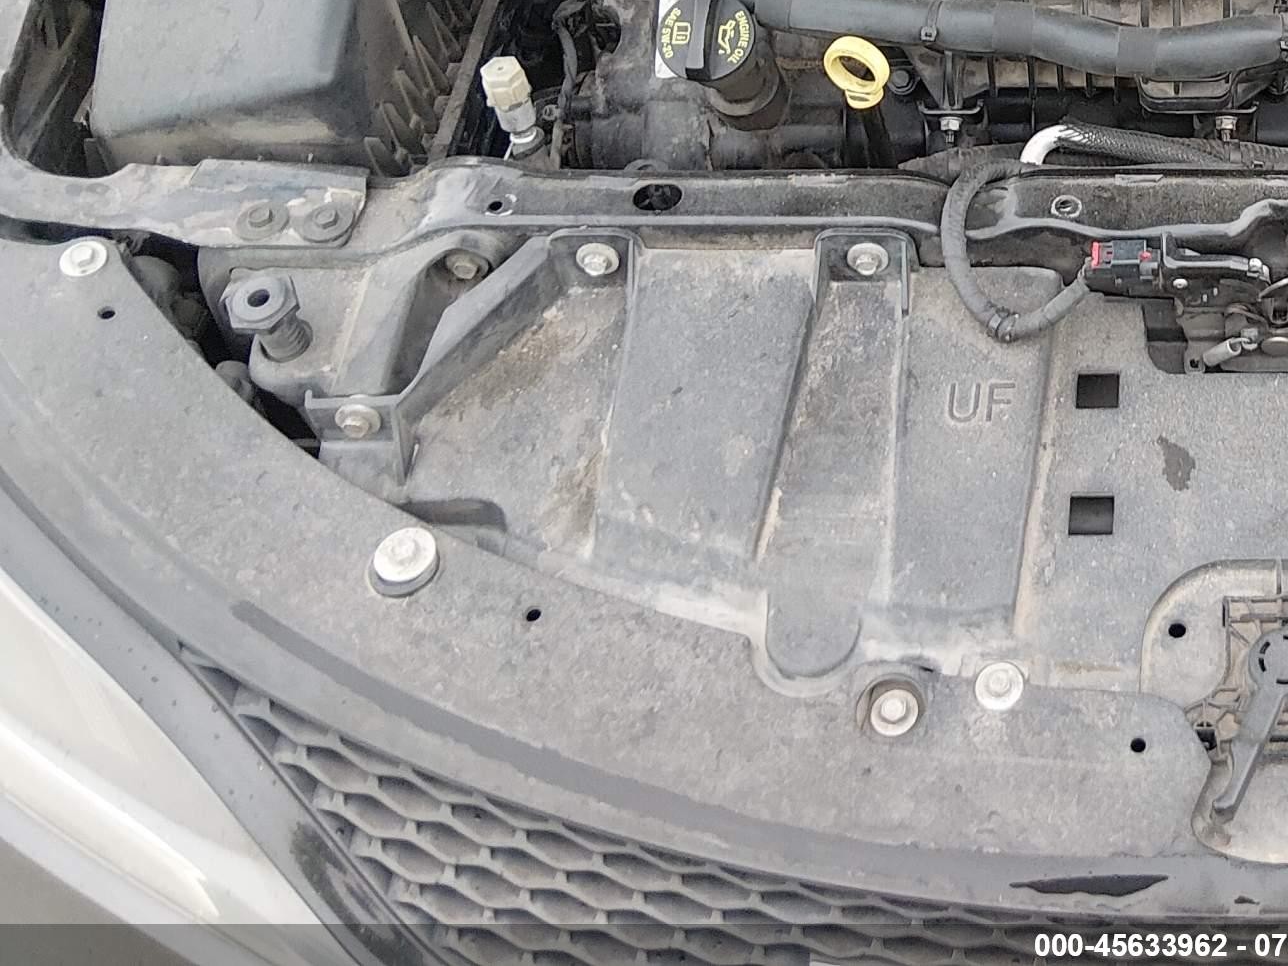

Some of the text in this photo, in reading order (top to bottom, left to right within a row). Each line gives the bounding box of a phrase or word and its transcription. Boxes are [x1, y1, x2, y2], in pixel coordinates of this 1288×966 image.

[664, 7, 682, 28] SAE
[727, 10, 750, 64] ENGINE OIL
[947, 380, 1017, 423] UF
